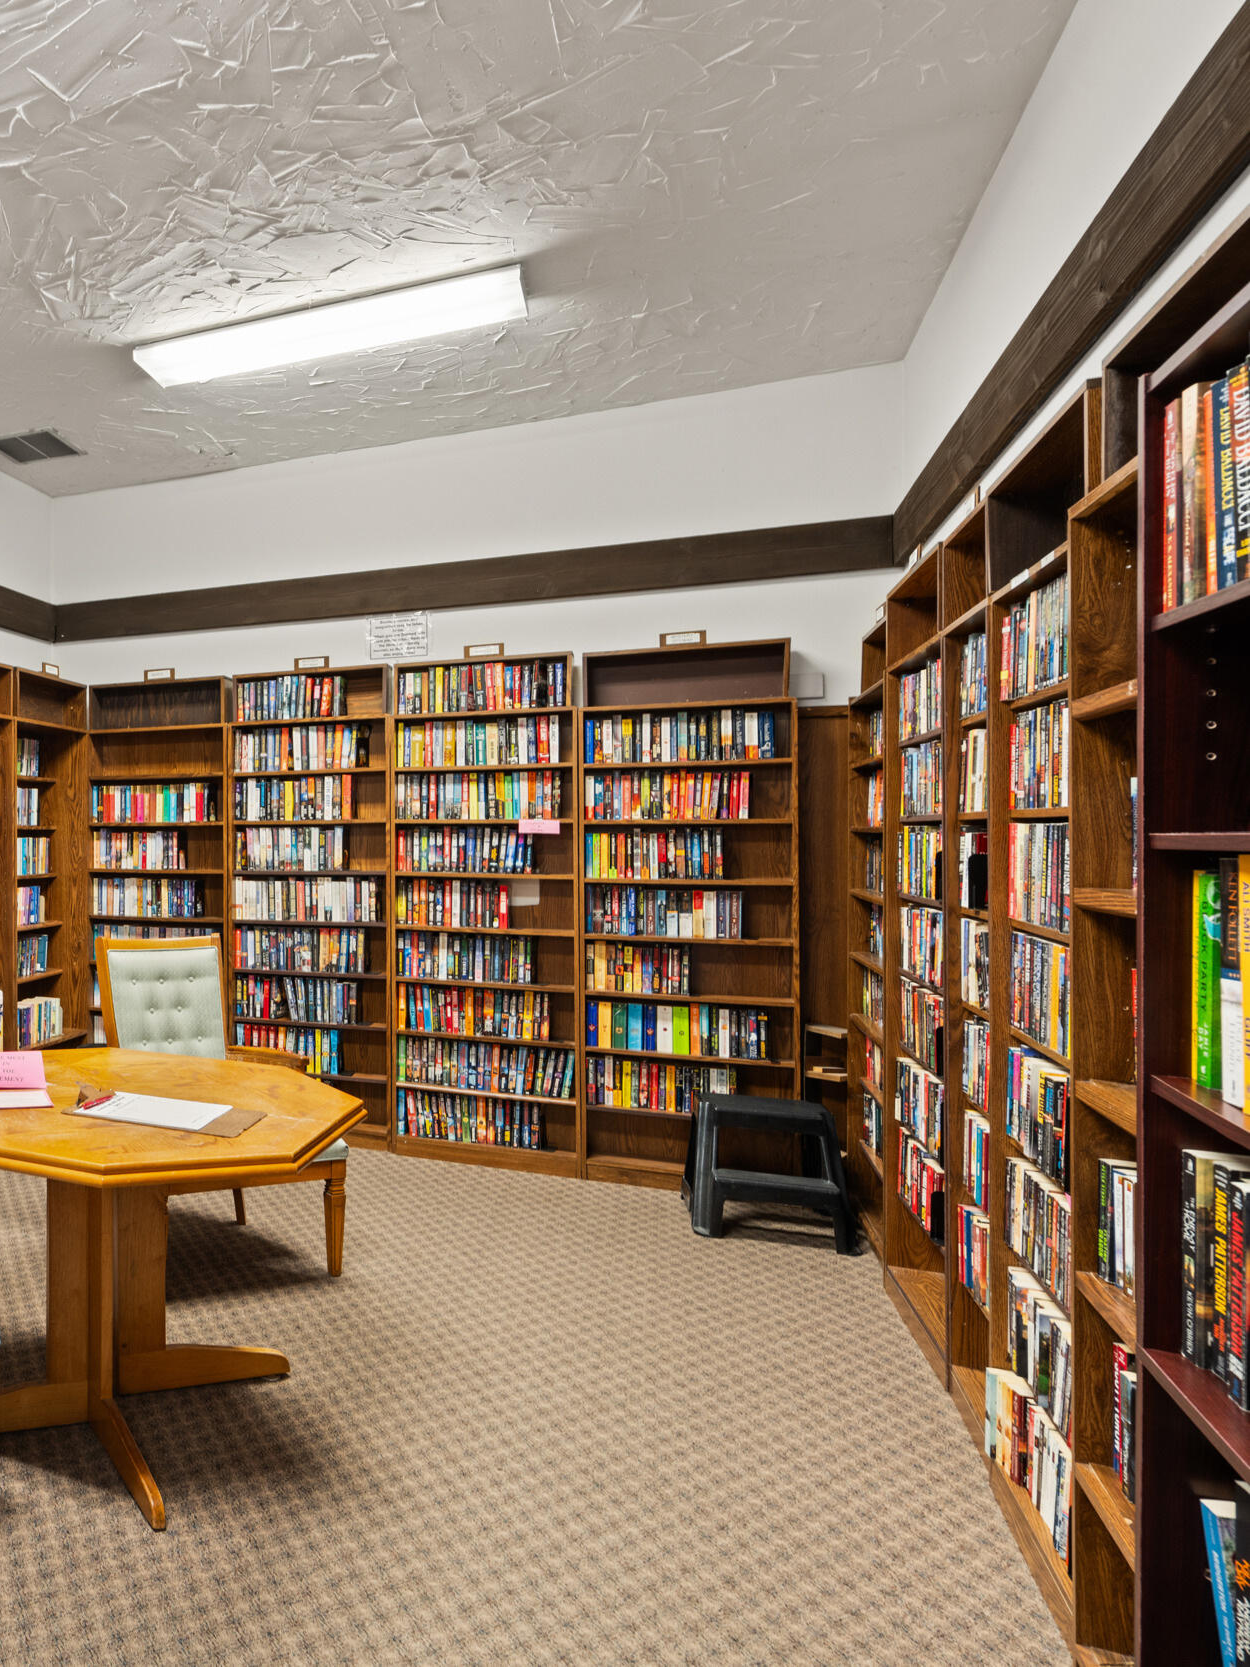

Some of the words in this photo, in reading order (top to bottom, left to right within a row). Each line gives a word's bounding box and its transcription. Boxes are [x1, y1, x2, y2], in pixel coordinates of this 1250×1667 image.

[1220, 407, 1231, 445] DAVID
[1232, 385, 1250, 441] DAVID
[1220, 447, 1234, 510] BALDACCI
[1235, 443, 1250, 532] BALDACCI
[1222, 527, 1236, 566] ESCAPE
[1228, 872, 1238, 901] KEN
[1227, 904, 1240, 963] FOLLETT
[1200, 961, 1208, 1012] PARTY
[1188, 1209, 1196, 1253] ENEMY
[1214, 1187, 1227, 1233] JAMES
[1230, 1211, 1244, 1265] JAMES
[1214, 1236, 1227, 1316] PATTERSON
[1186, 1290, 1194, 1317] KEVIN
[1230, 1266, 1243, 1359] PATTERSON
